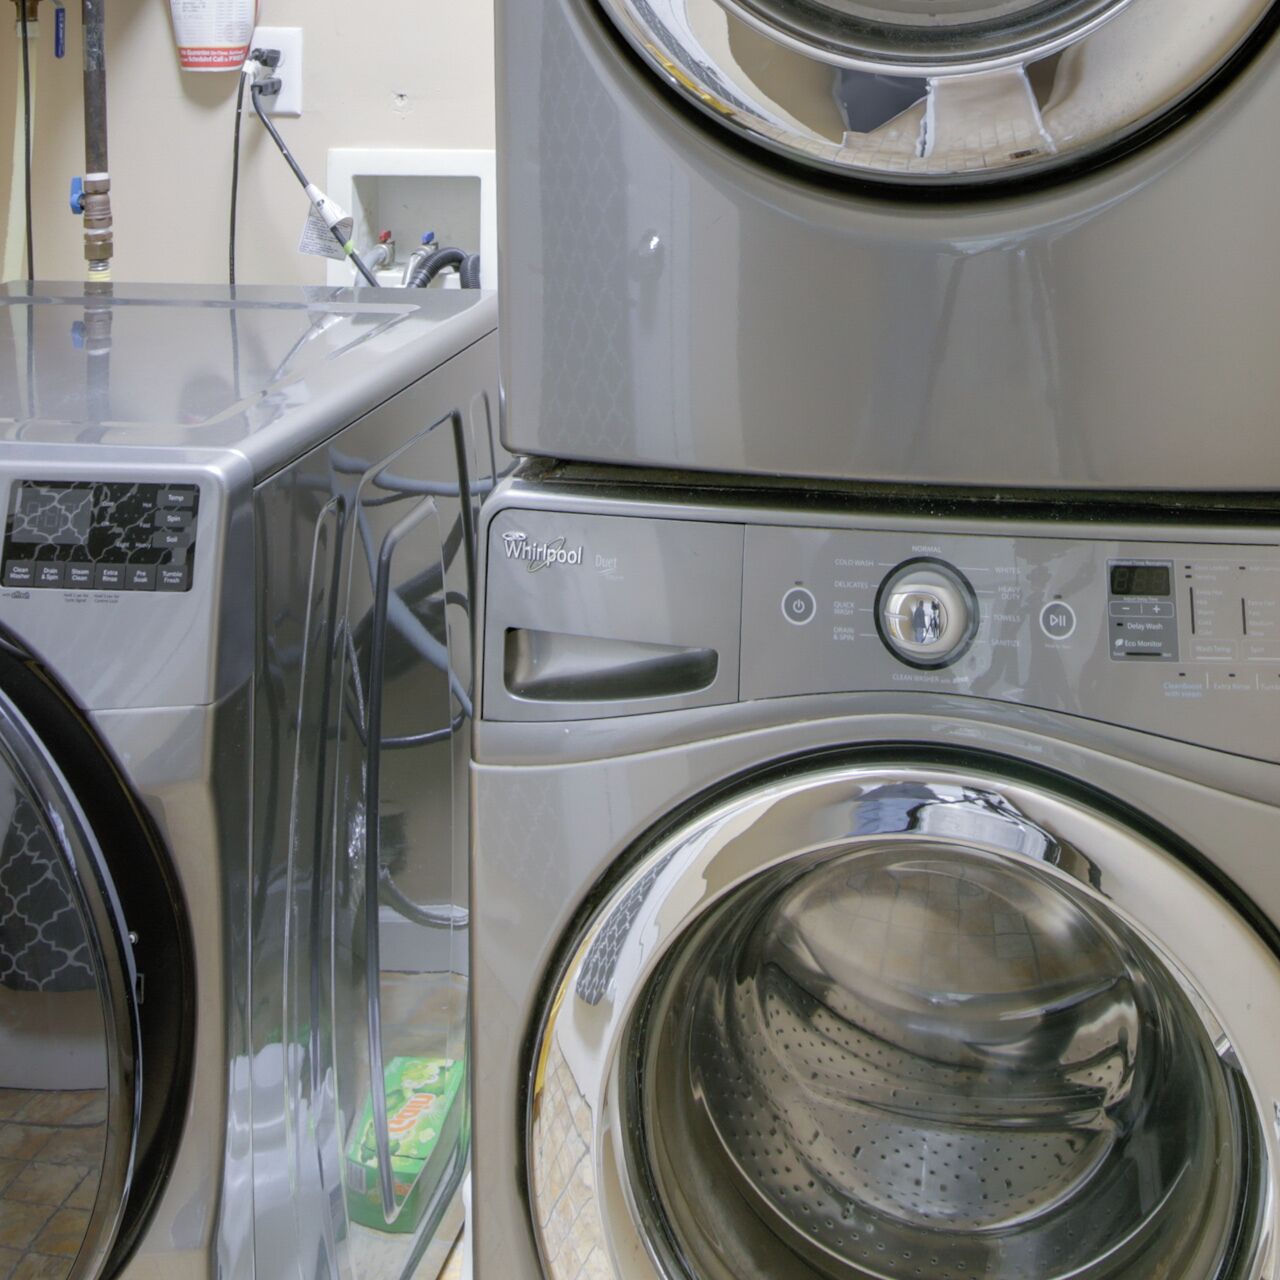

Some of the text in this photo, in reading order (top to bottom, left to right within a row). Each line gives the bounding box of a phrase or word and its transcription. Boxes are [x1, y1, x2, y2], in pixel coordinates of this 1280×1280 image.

[168, 494, 184, 502] Temp
[912, 545, 942, 553] NORMAL
[504, 540, 583, 567] Whirlpool
[595, 554, 618, 568] Duet
[834, 581, 868, 589] DELICATES
[834, 608, 854, 616] WASH
[1128, 622, 1163, 630] Delay Wash
[840, 634, 854, 642] SPIN
[991, 639, 1020, 647] SANITIZE
[1137, 640, 1162, 648] Monitor
